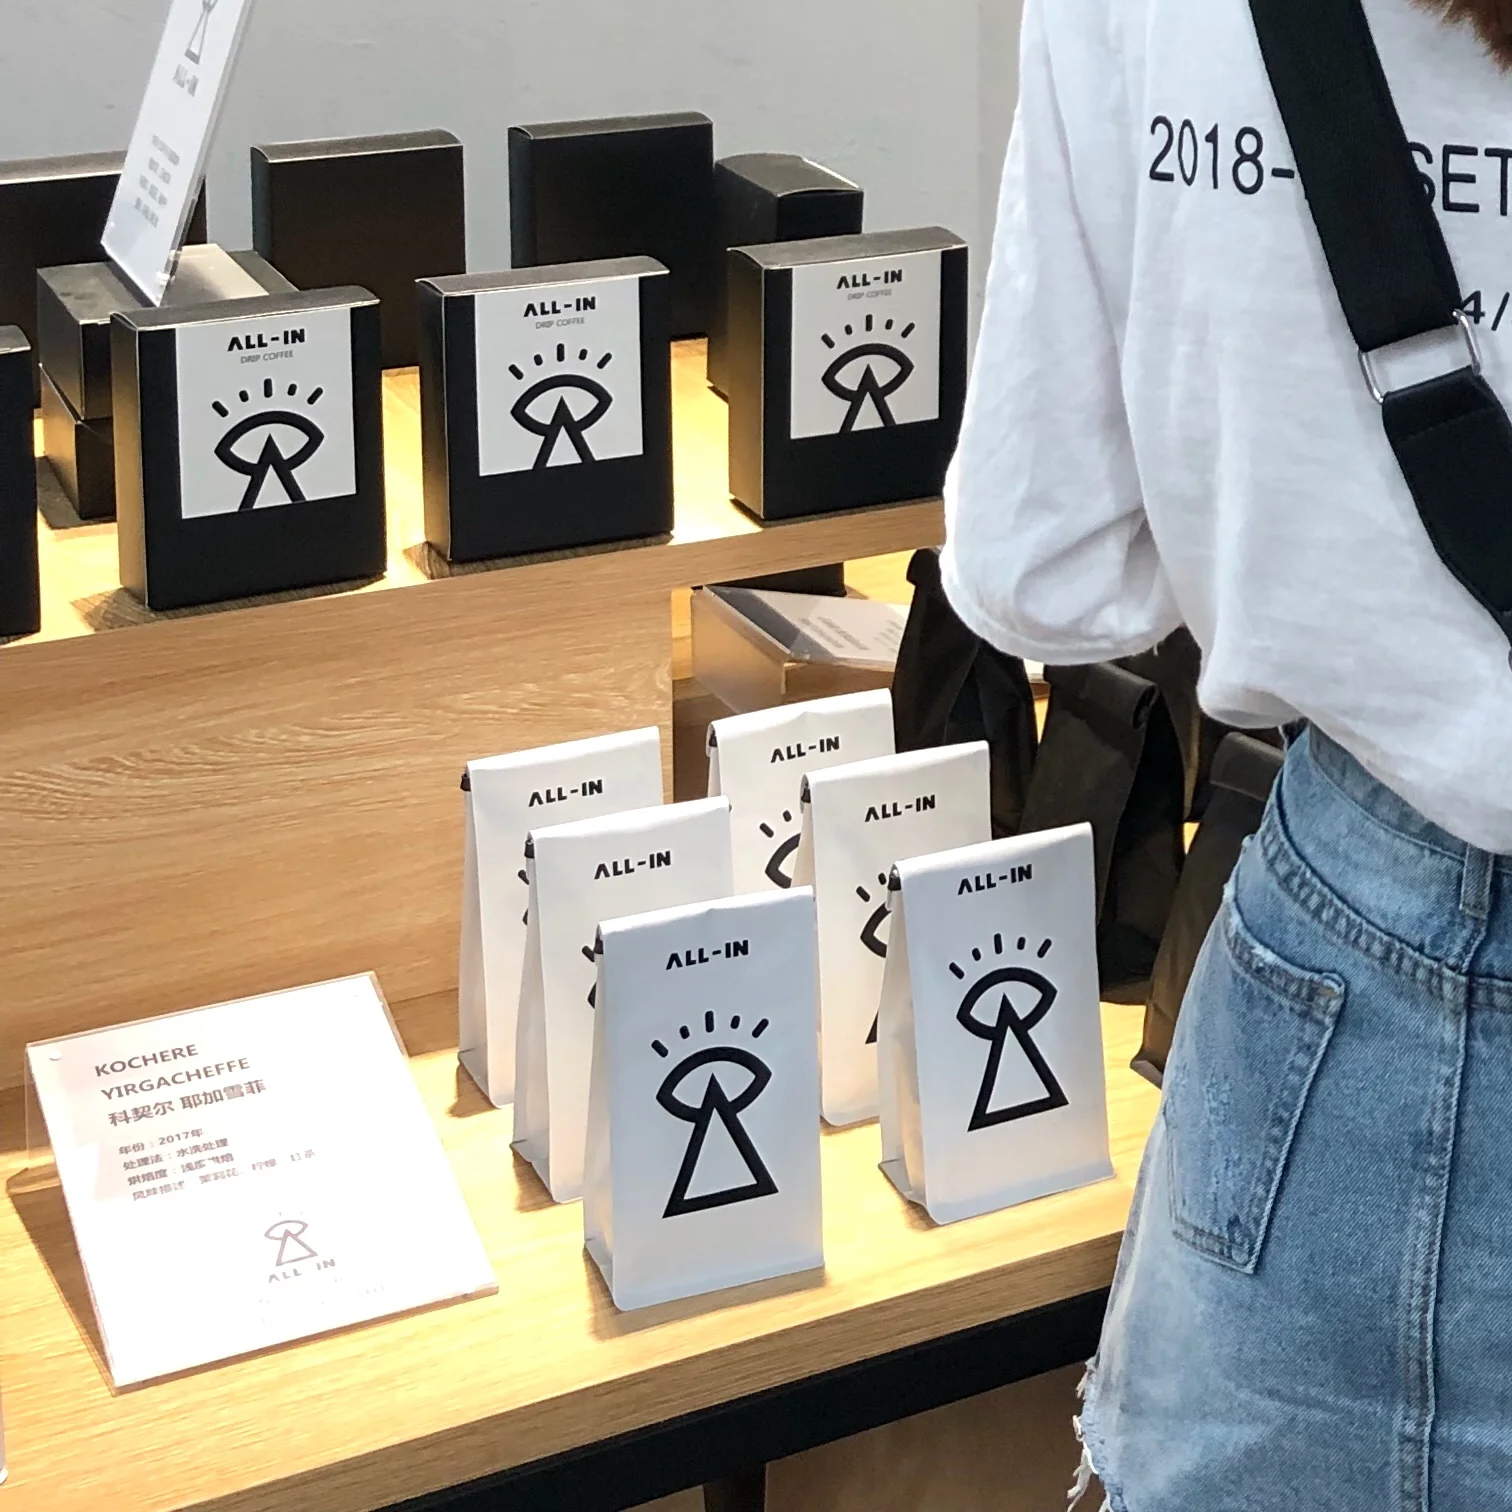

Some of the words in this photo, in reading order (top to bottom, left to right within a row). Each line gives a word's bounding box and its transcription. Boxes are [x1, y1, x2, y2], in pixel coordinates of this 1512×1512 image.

[837, 269, 903, 290] ALL-IN
[523, 296, 596, 318] ALL-IN
[556, 317, 585, 327] COFFEE
[227, 328, 305, 352] ALL-IN
[240, 354, 261, 364] DRIP
[262, 350, 294, 361] COFFEE
[771, 736, 840, 763] ALL-IN
[529, 779, 603, 807] ALL-IN
[865, 794, 936, 822] ALL-IN
[595, 850, 671, 879] ALL-IN
[958, 863, 1033, 895] ALL-IN
[666, 939, 749, 970] ALL-IN
[94, 1044, 199, 1078] KOCHERE
[101, 1057, 251, 1100] YIRGACHEFFE
[108, 1100, 175, 1127] 科契尔
[180, 1079, 266, 1110] 耶加雪菲
